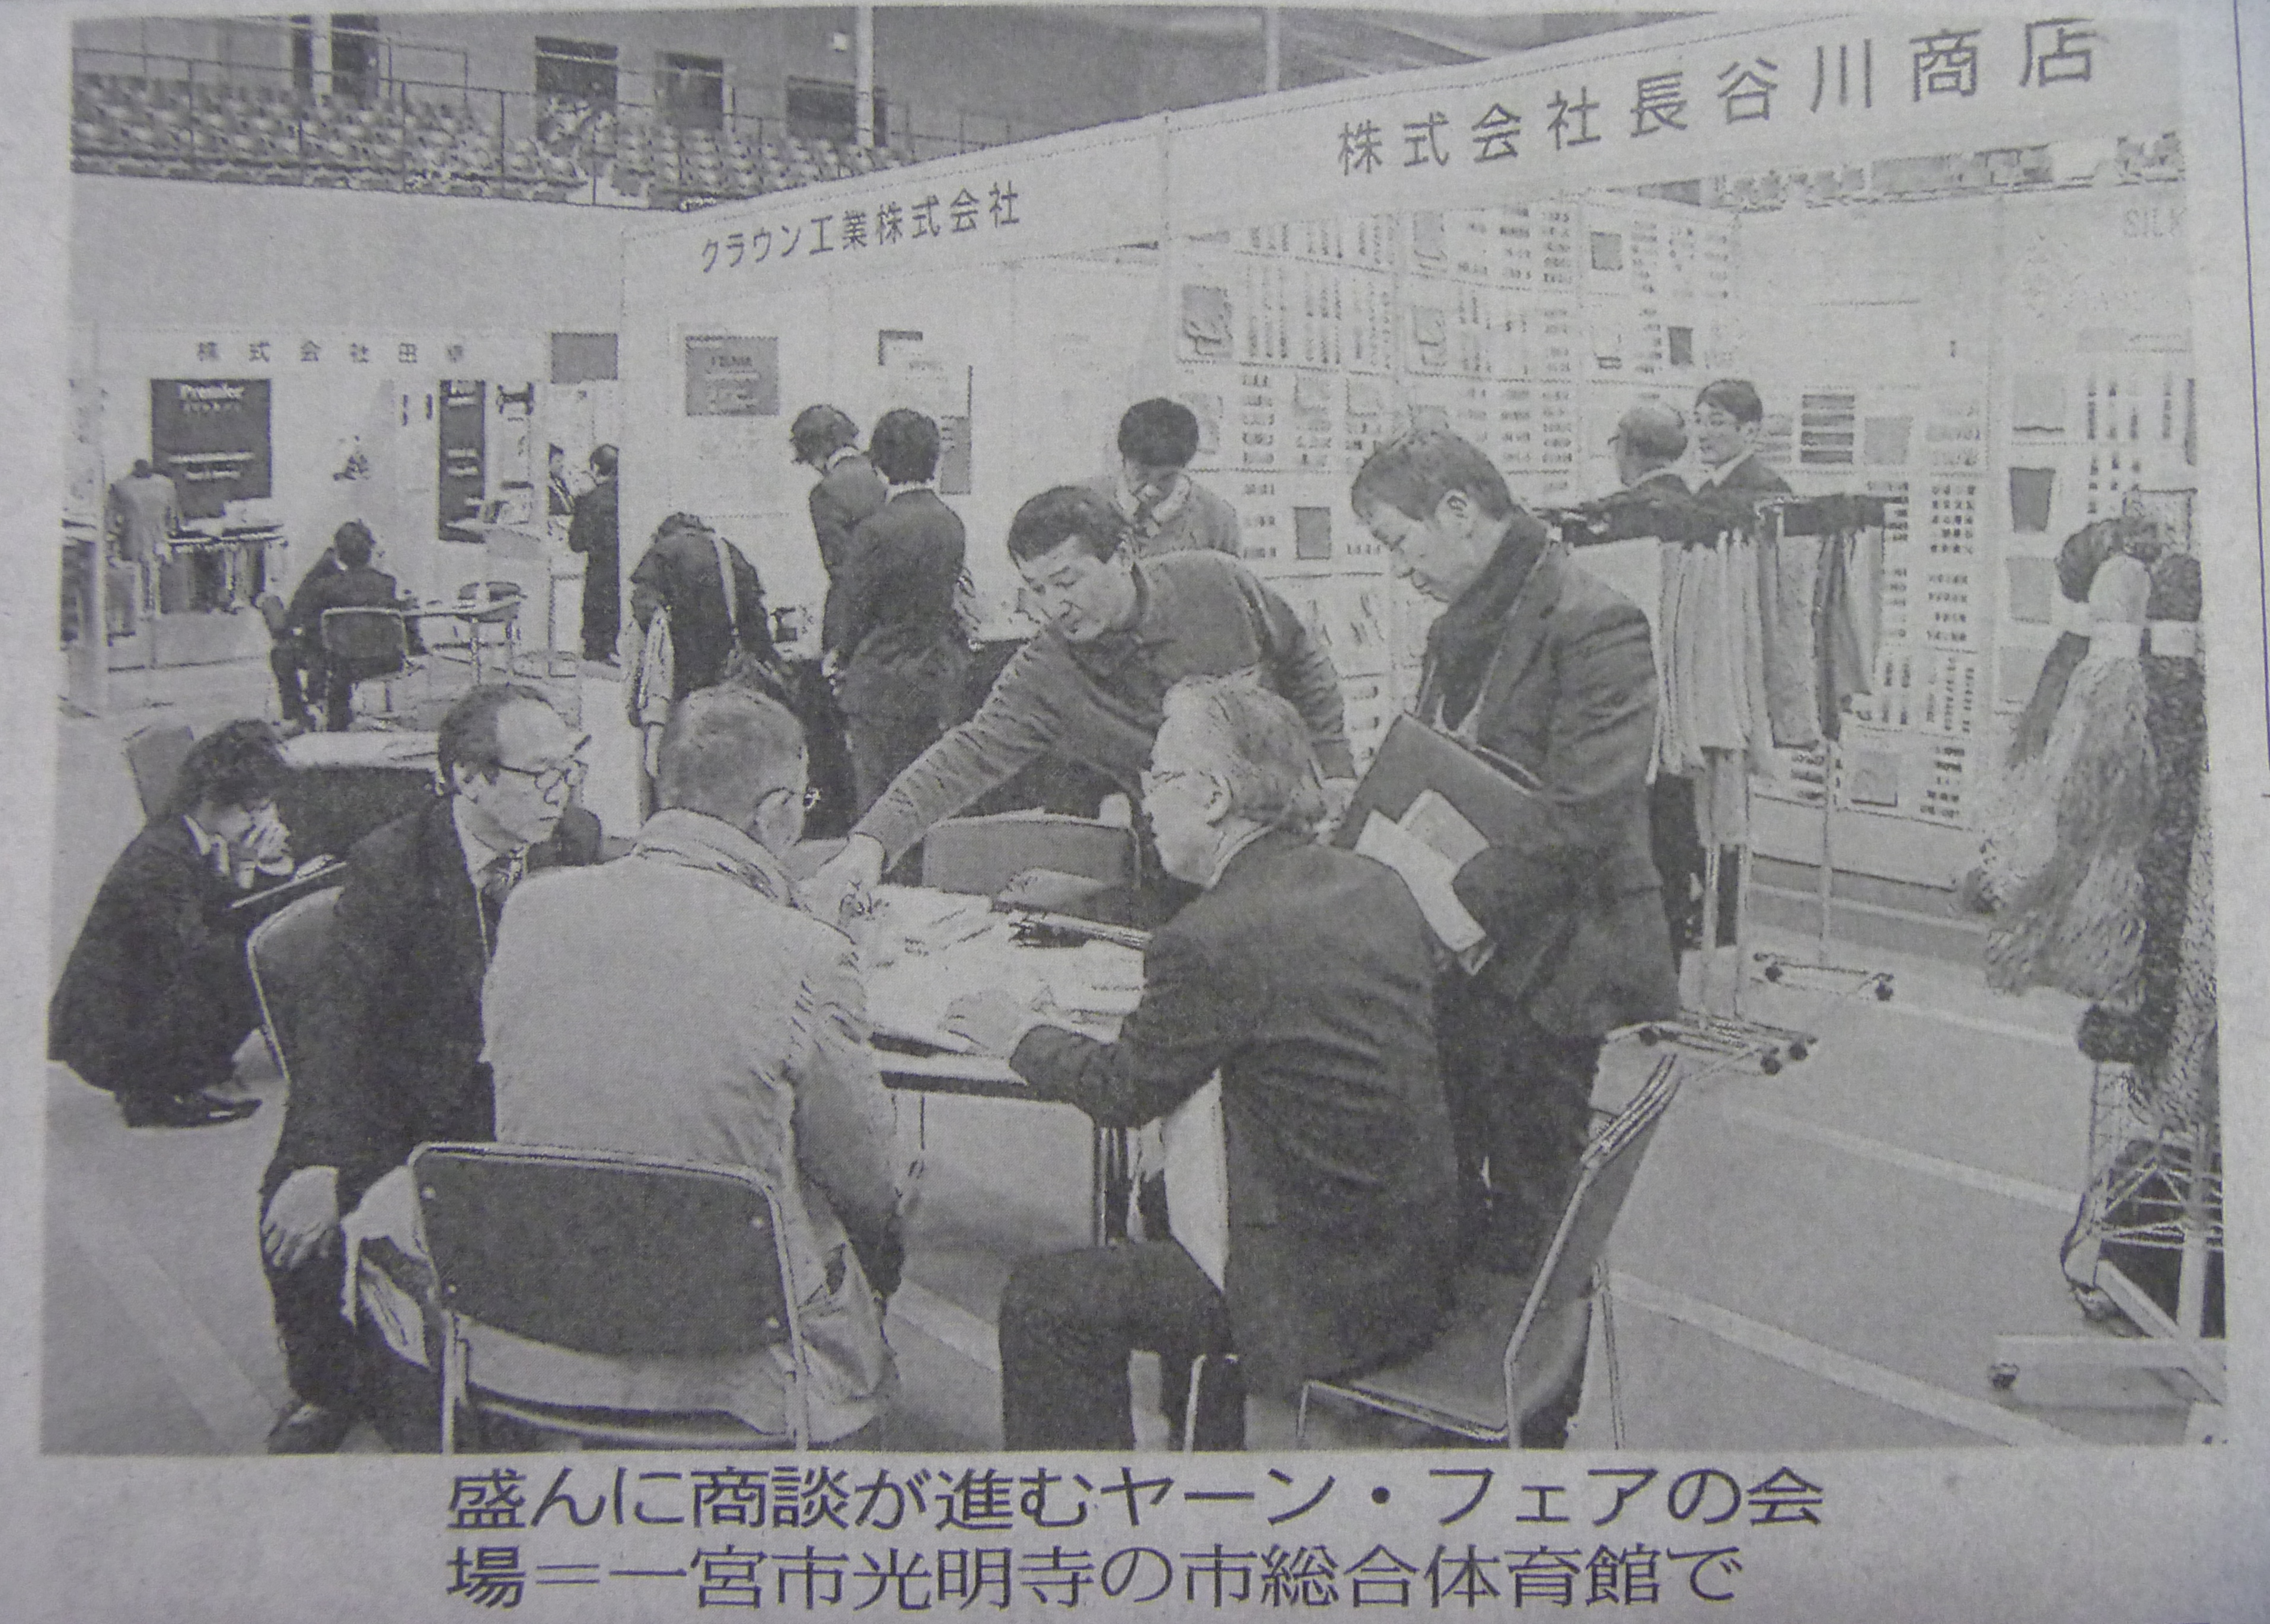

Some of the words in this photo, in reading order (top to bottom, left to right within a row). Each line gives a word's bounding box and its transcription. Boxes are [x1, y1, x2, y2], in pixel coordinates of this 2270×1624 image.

[1338, 17, 2097, 176] 株式会社長谷川商店
[702, 180, 1019, 273] クラウン工業株式会社
[447, 1465, 1823, 1532] 盛んに商談が進むヤーン・フェアの会
